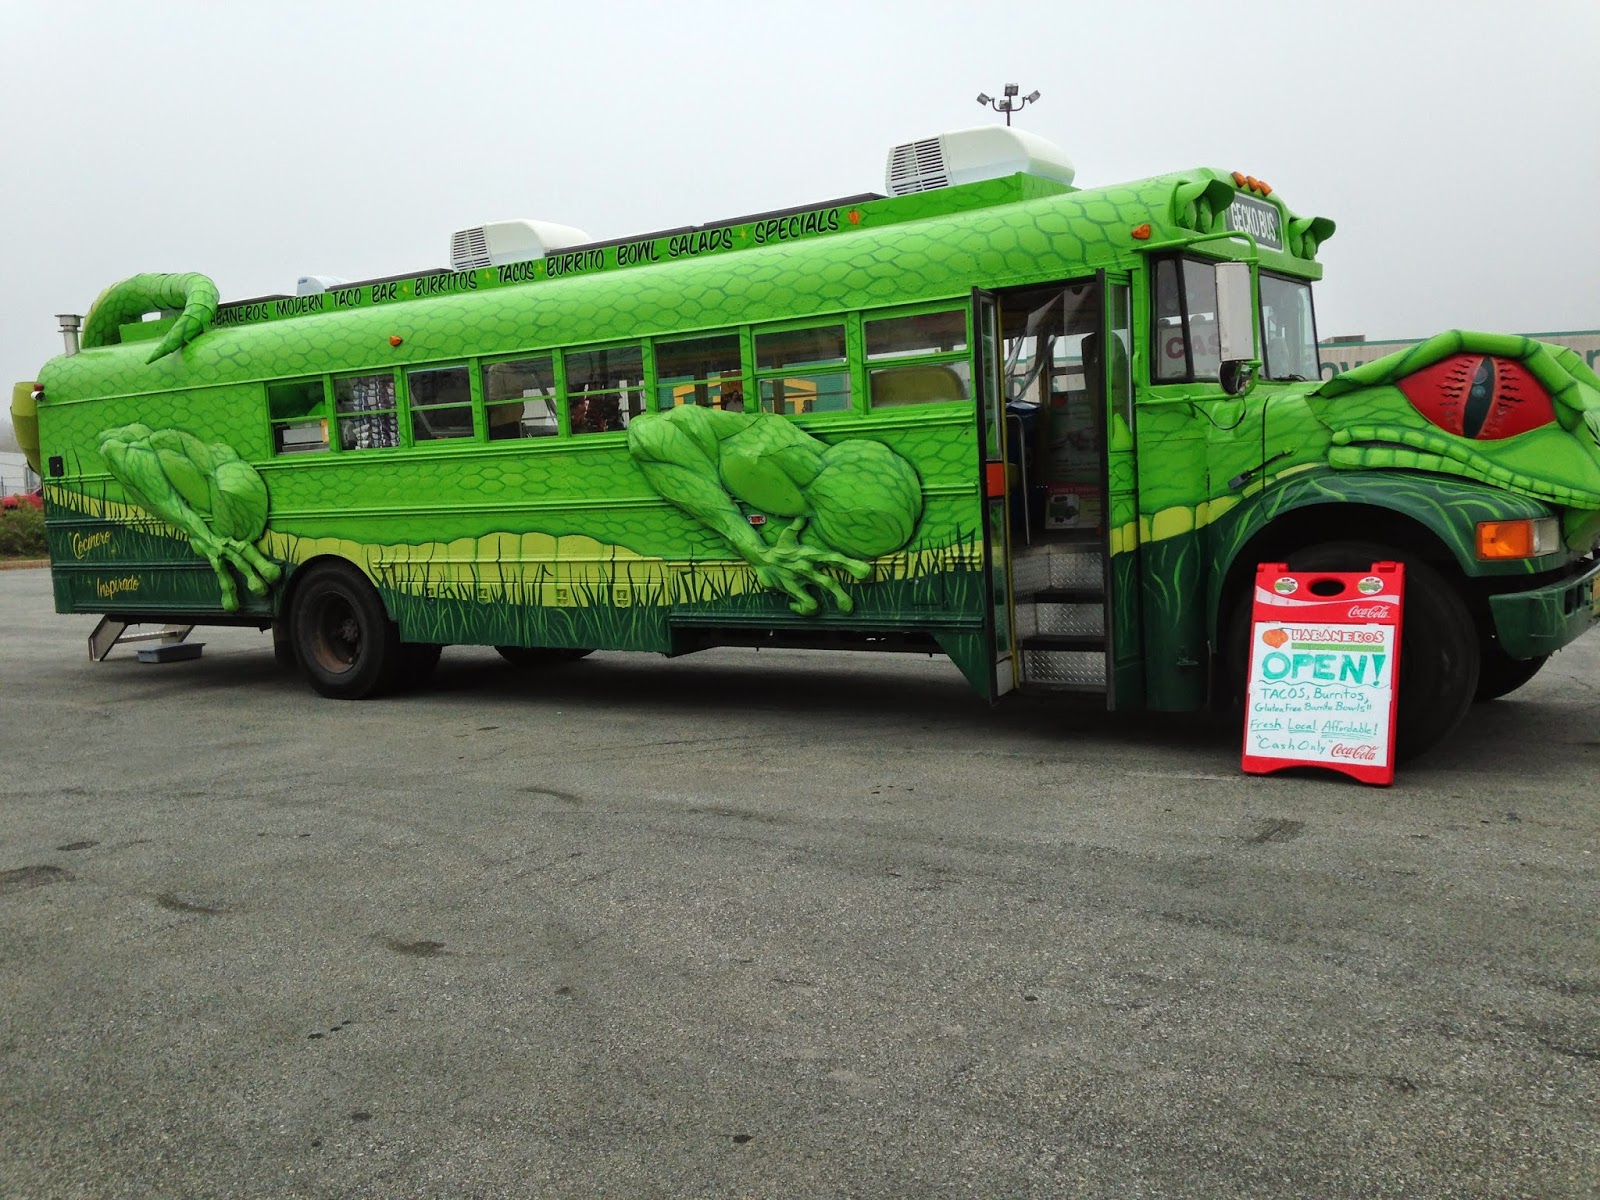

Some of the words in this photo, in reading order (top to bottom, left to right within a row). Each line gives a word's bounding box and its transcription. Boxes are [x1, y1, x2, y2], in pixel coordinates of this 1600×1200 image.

[208, 302, 269, 326] ABANEROS
[275, 293, 323, 317] MODERN
[331, 288, 361, 307] TACO
[371, 281, 397, 304] BAR
[414, 270, 477, 297] BURRITOS
[497, 260, 535, 284] TACOS
[546, 249, 605, 278] BURRITO
[616, 240, 661, 267] BOWL
[668, 227, 733, 258] SALADS
[753, 208, 839, 244] SPECIALS
[1291, 629, 1385, 643] HABANEROS
[1262, 651, 1387, 687] OPEN!
[1260, 687, 1310, 700] TACOS,
[1254, 702, 1285, 713] Gluten
[1285, 703, 1303, 713] Free
[1321, 720, 1379, 736] Affordable!
